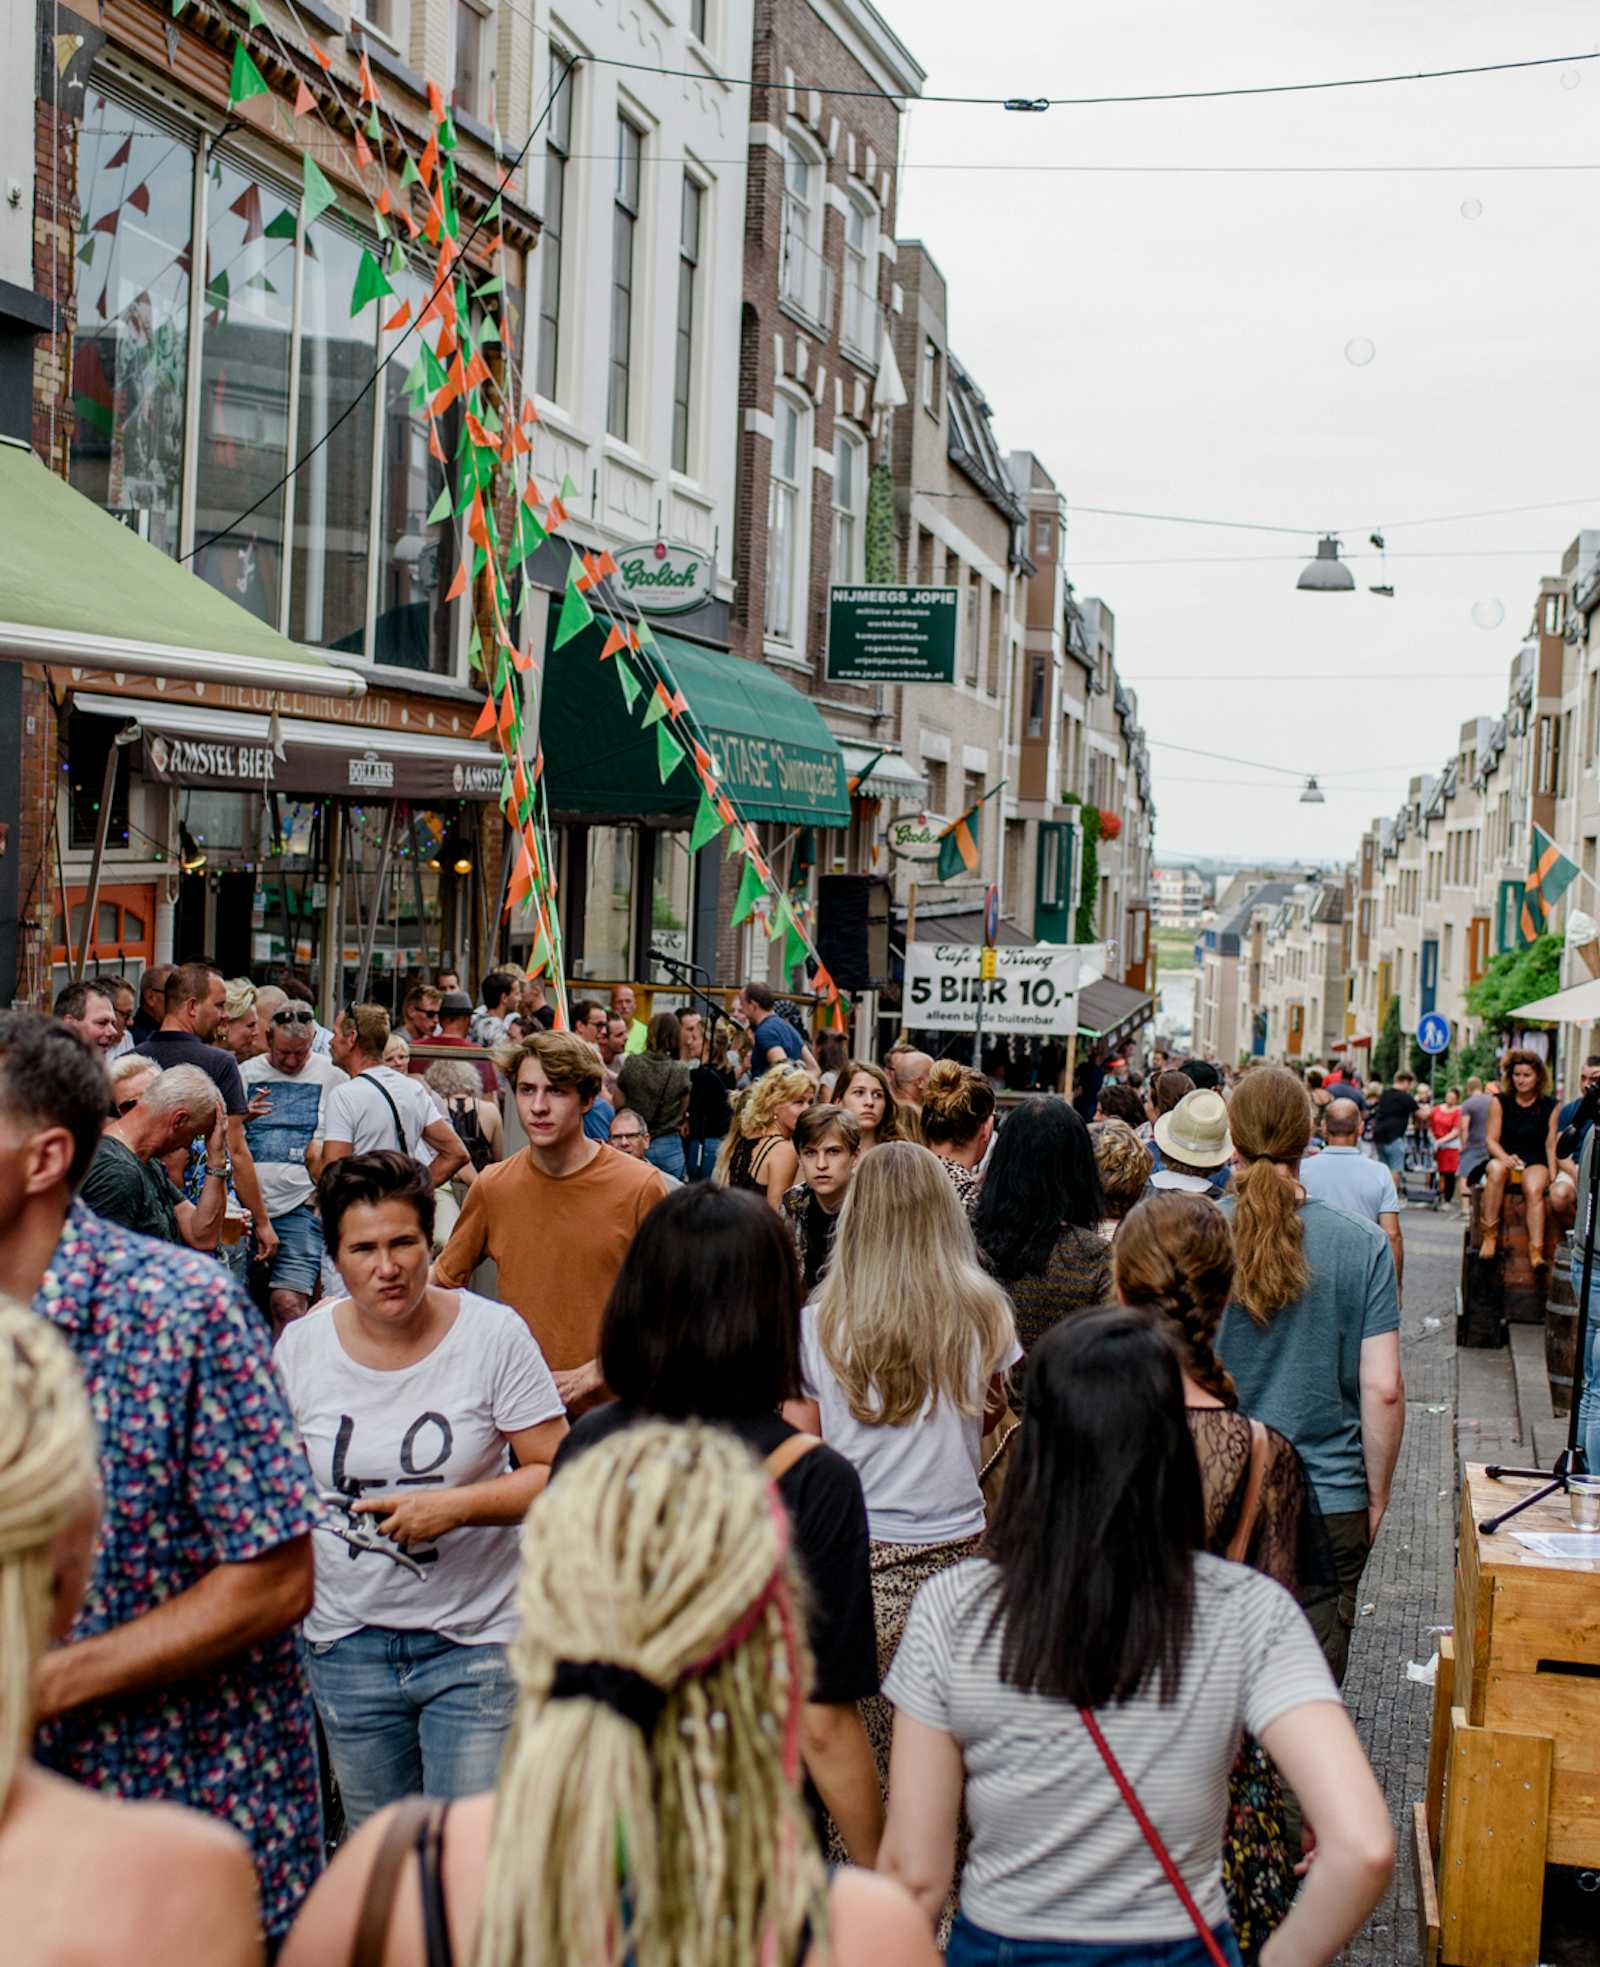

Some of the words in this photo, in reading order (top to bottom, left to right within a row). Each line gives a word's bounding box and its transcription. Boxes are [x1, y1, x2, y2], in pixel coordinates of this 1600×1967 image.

[620, 559, 699, 590] Grolsch
[832, 589, 908, 603] NIJMEEGS
[911, 591, 955, 605] JOPIE
[170, 740, 235, 777] AMSTEL
[239, 747, 275, 779] BIER
[910, 976, 932, 1004] 5
[925, 1011, 961, 1021] alleen
[997, 1013, 1055, 1025] buitenbar
